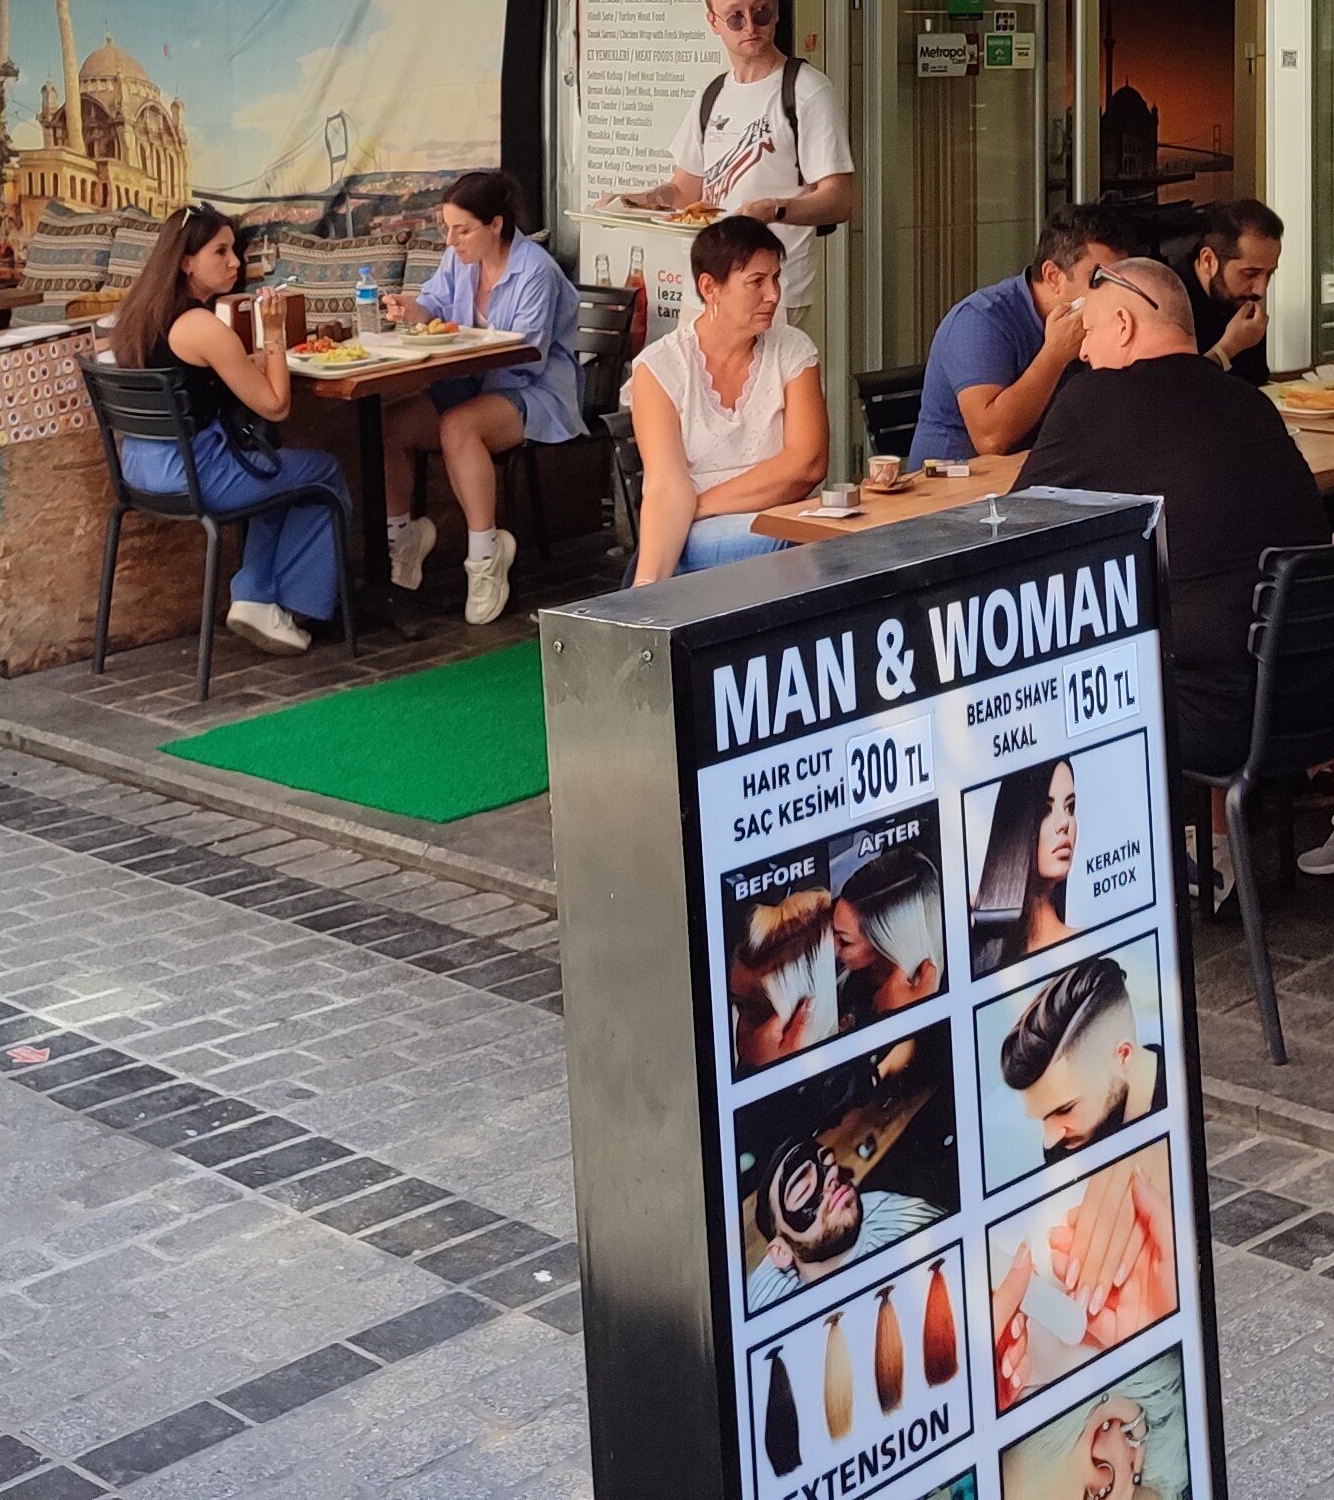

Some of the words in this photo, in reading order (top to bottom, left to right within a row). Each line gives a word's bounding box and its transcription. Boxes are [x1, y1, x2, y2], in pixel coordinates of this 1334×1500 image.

[920, 46, 966, 60] Metropol
[713, 629, 858, 752] MAN
[875, 617, 917, 701] &
[929, 554, 1140, 684] WOMAN
[966, 691, 1012, 728] BEARD
[1014, 677, 1059, 713] SHAVE
[1067, 664, 1109, 725] 150
[1113, 671, 1137, 708] TL
[992, 722, 1038, 758] SAKAL
[742, 759, 791, 800] HAIR
[795, 748, 834, 787] CUT
[850, 737, 898, 805] 300
[904, 745, 930, 789] TL
[733, 803, 774, 844] SAÇ
[778, 776, 846, 831] KESİMİ
[858, 818, 921, 858] AFTER
[1085, 838, 1142, 876] KERATİN
[734, 857, 817, 901] BEFORE
[1092, 868, 1138, 899] BOTOX
